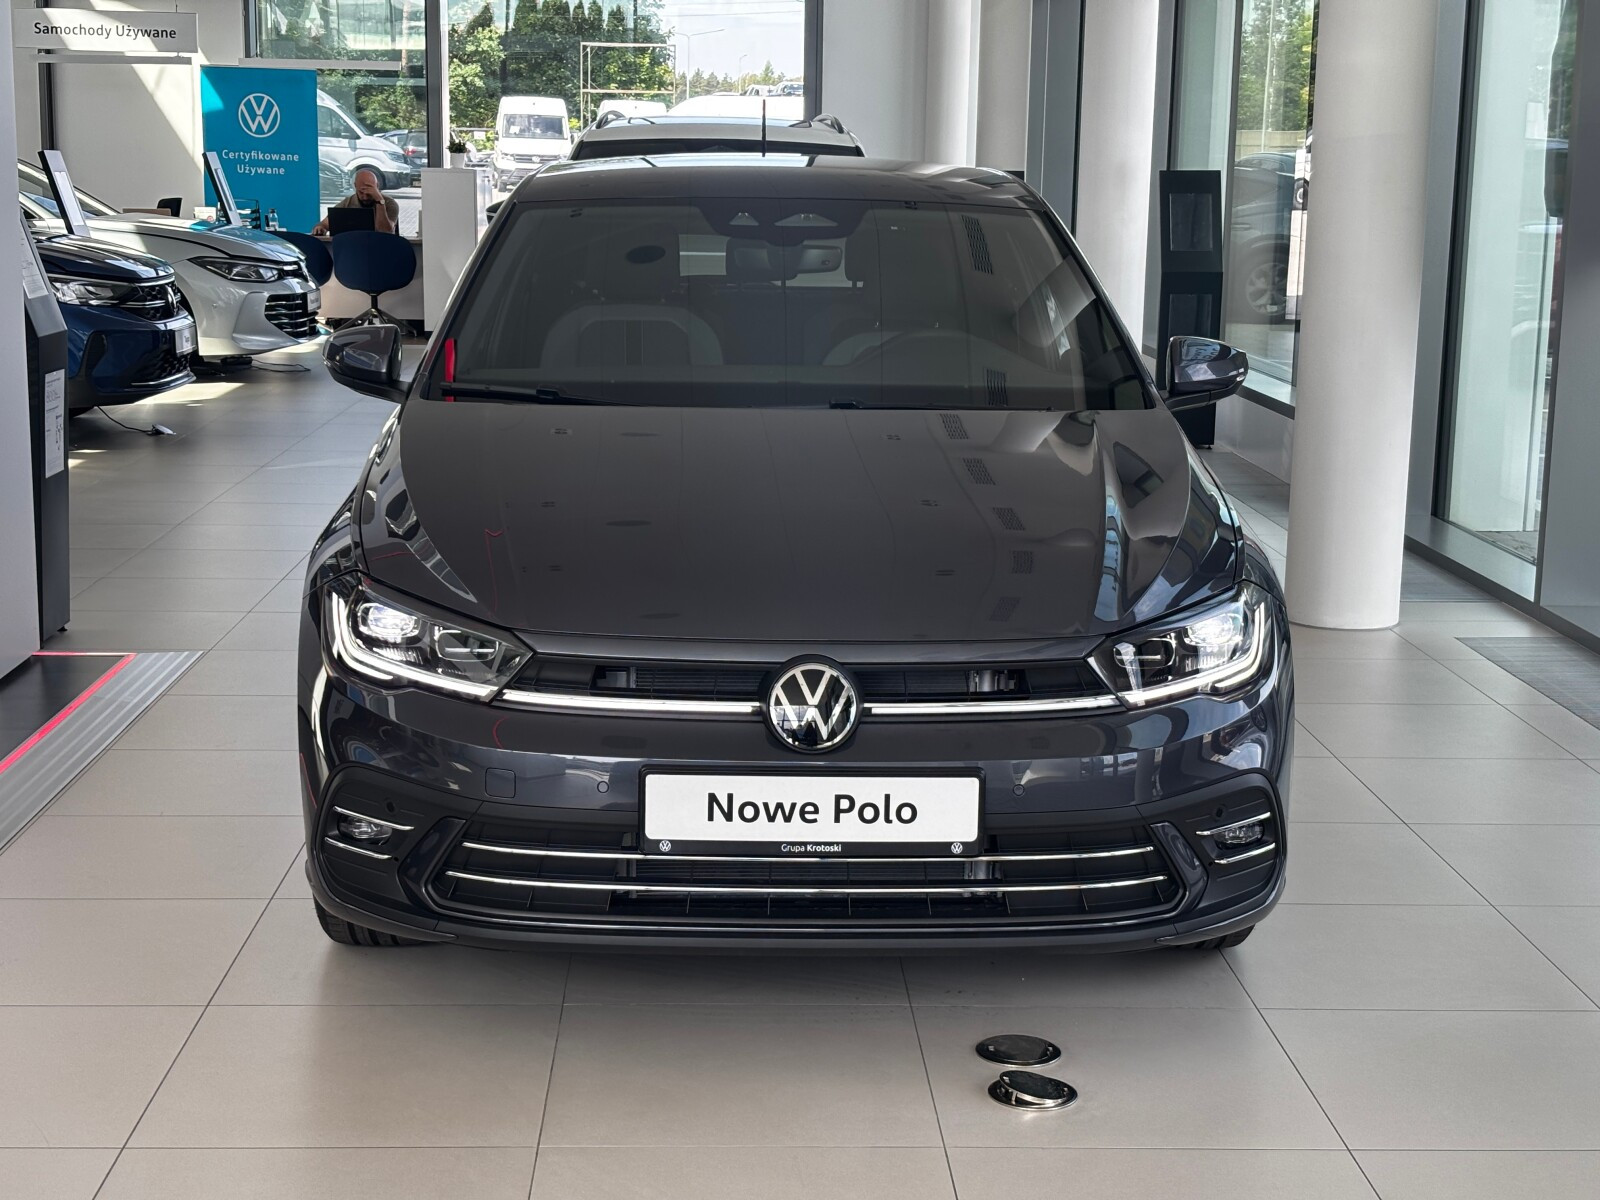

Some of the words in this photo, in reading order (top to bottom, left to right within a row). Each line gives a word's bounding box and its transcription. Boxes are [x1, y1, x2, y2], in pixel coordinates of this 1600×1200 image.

[34, 22, 111, 39] Samochody
[116, 24, 177, 40] Używane
[238, 93, 280, 137] VW
[222, 149, 299, 162] Certyfikowane
[237, 163, 285, 176] Używane
[770, 663, 857, 749] VW
[707, 793, 820, 823] Nowe
[833, 793, 918, 824] Polo
[781, 843, 805, 853] Grupa
[806, 843, 842, 852] Krotoski
